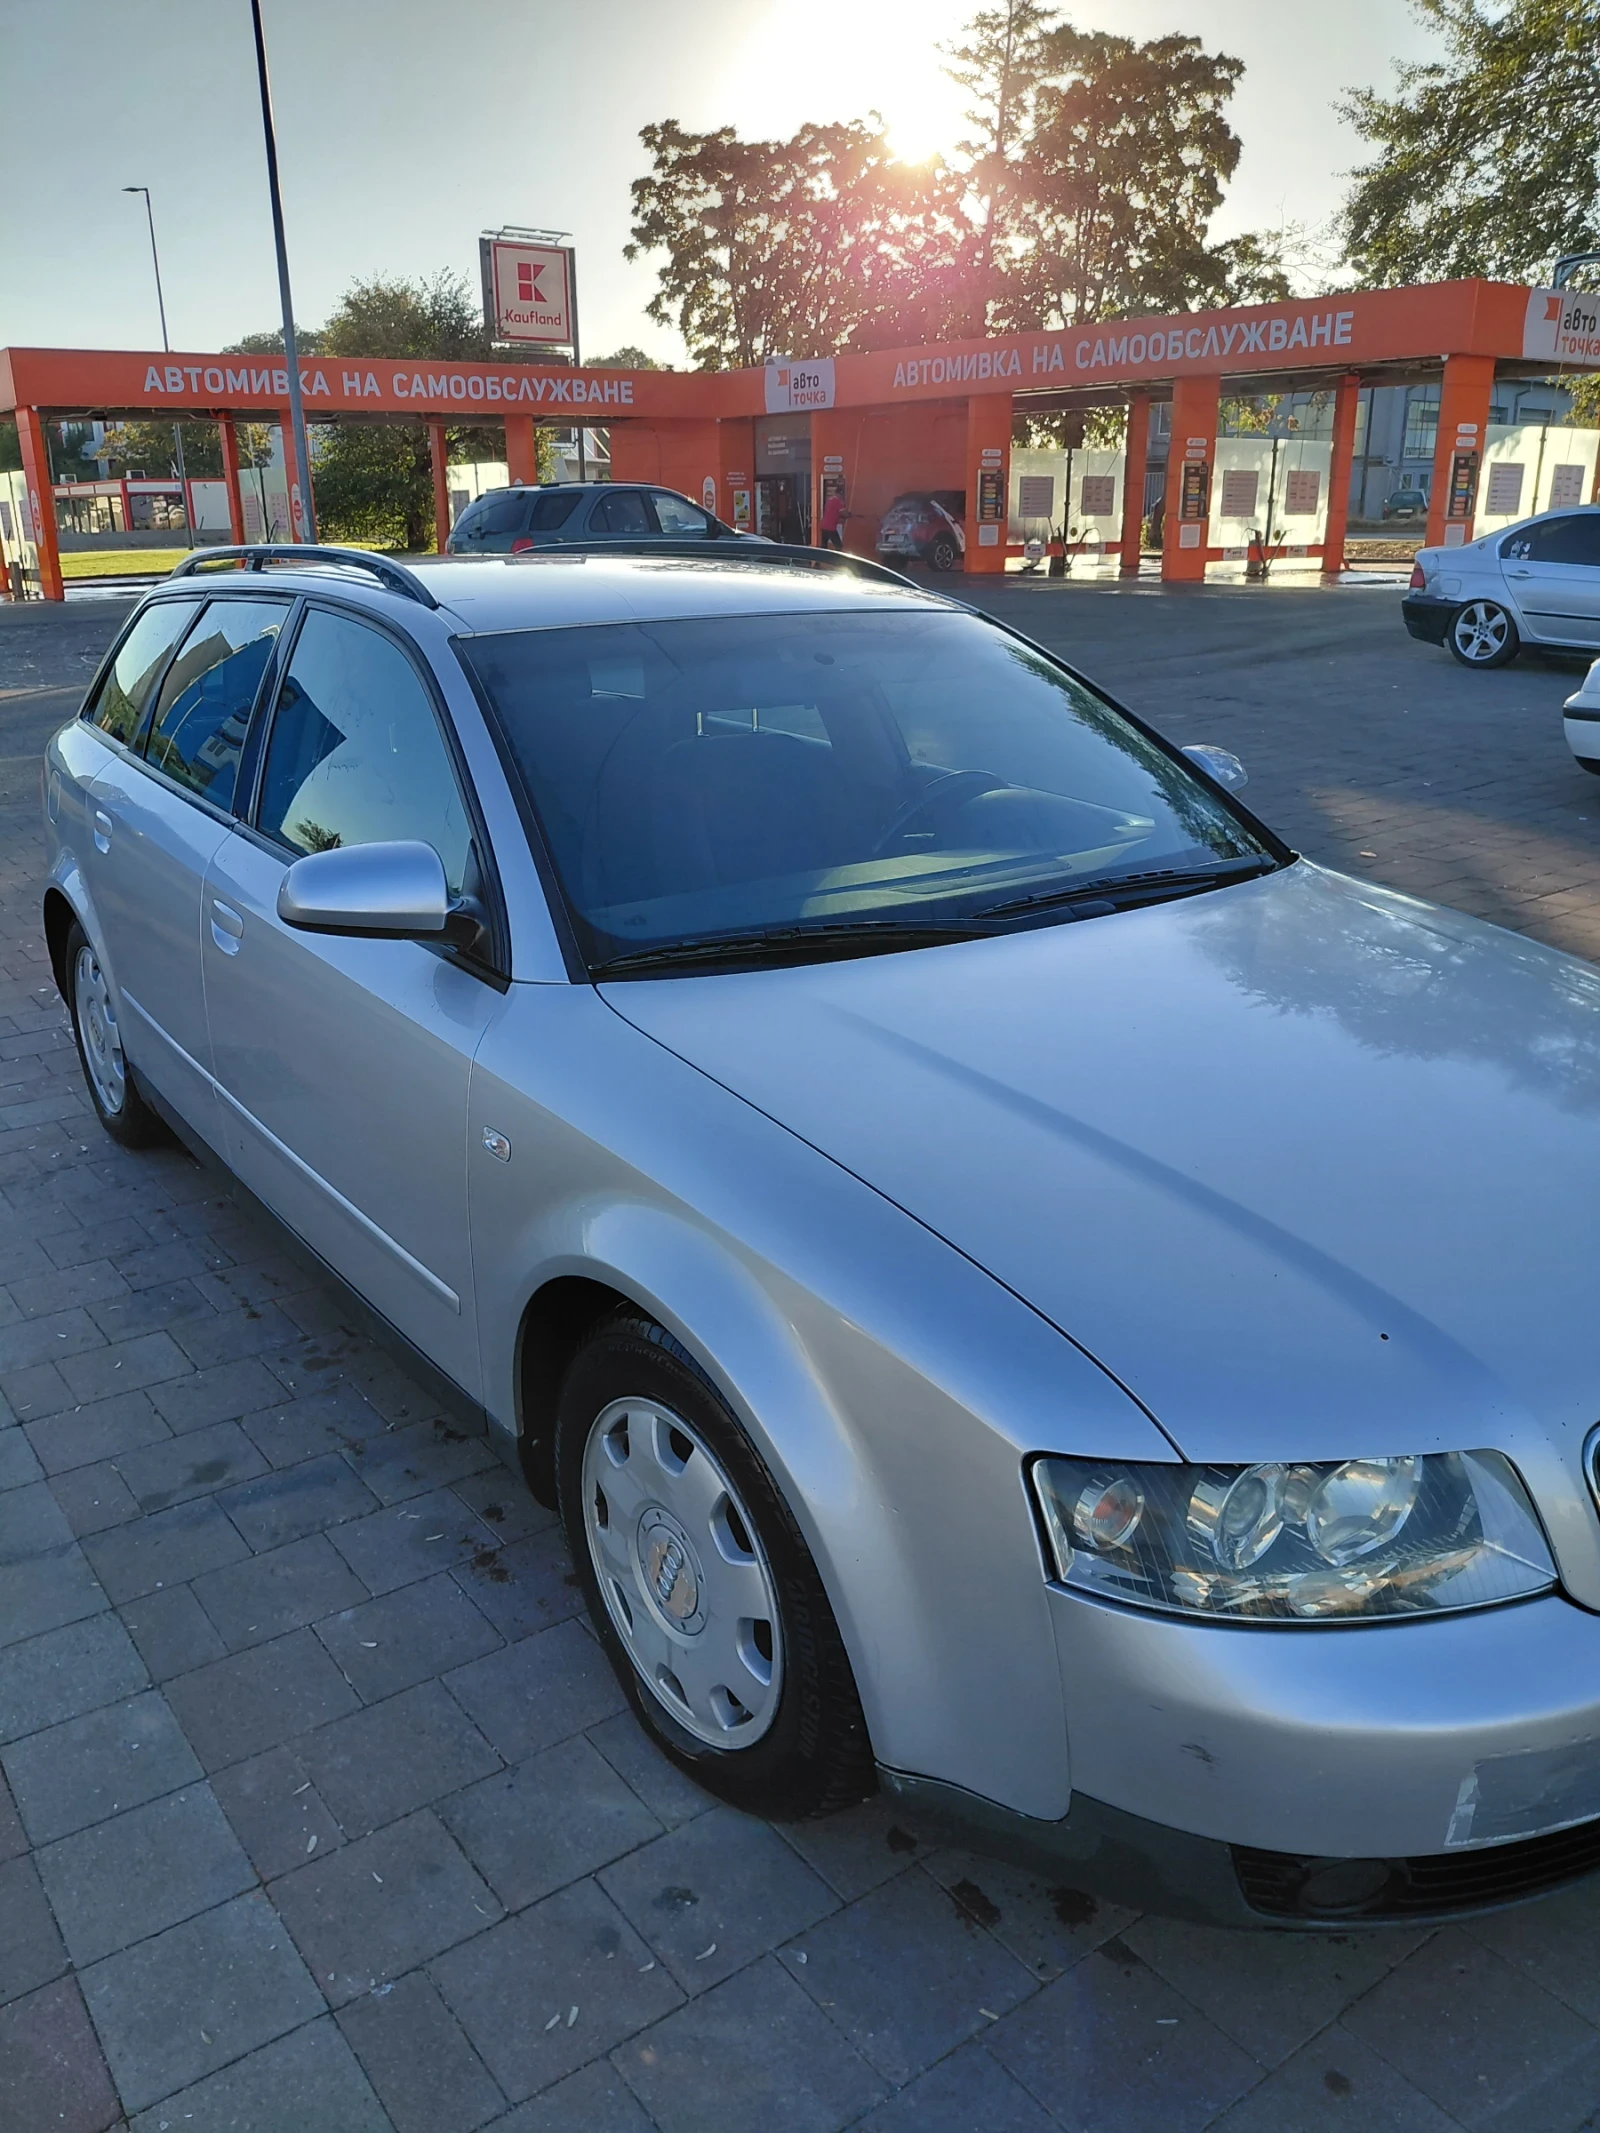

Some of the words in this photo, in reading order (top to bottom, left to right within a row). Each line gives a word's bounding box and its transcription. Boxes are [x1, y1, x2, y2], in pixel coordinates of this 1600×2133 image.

[505, 308, 562, 326] Kaufland
[1563, 307, 1597, 333] авто
[893, 348, 1022, 388] АВТОМИВКА
[1032, 343, 1065, 374] НА
[1075, 311, 1354, 370] САМООБСЛУЖВАНЕ
[1561, 335, 1600, 356] точка
[143, 366, 331, 396] АВТОМИВКА
[342, 371, 382, 397] НА
[392, 373, 634, 404] САМООБСЛУЖВАНЕ
[793, 372, 820, 390] авто
[793, 390, 827, 406] точка
